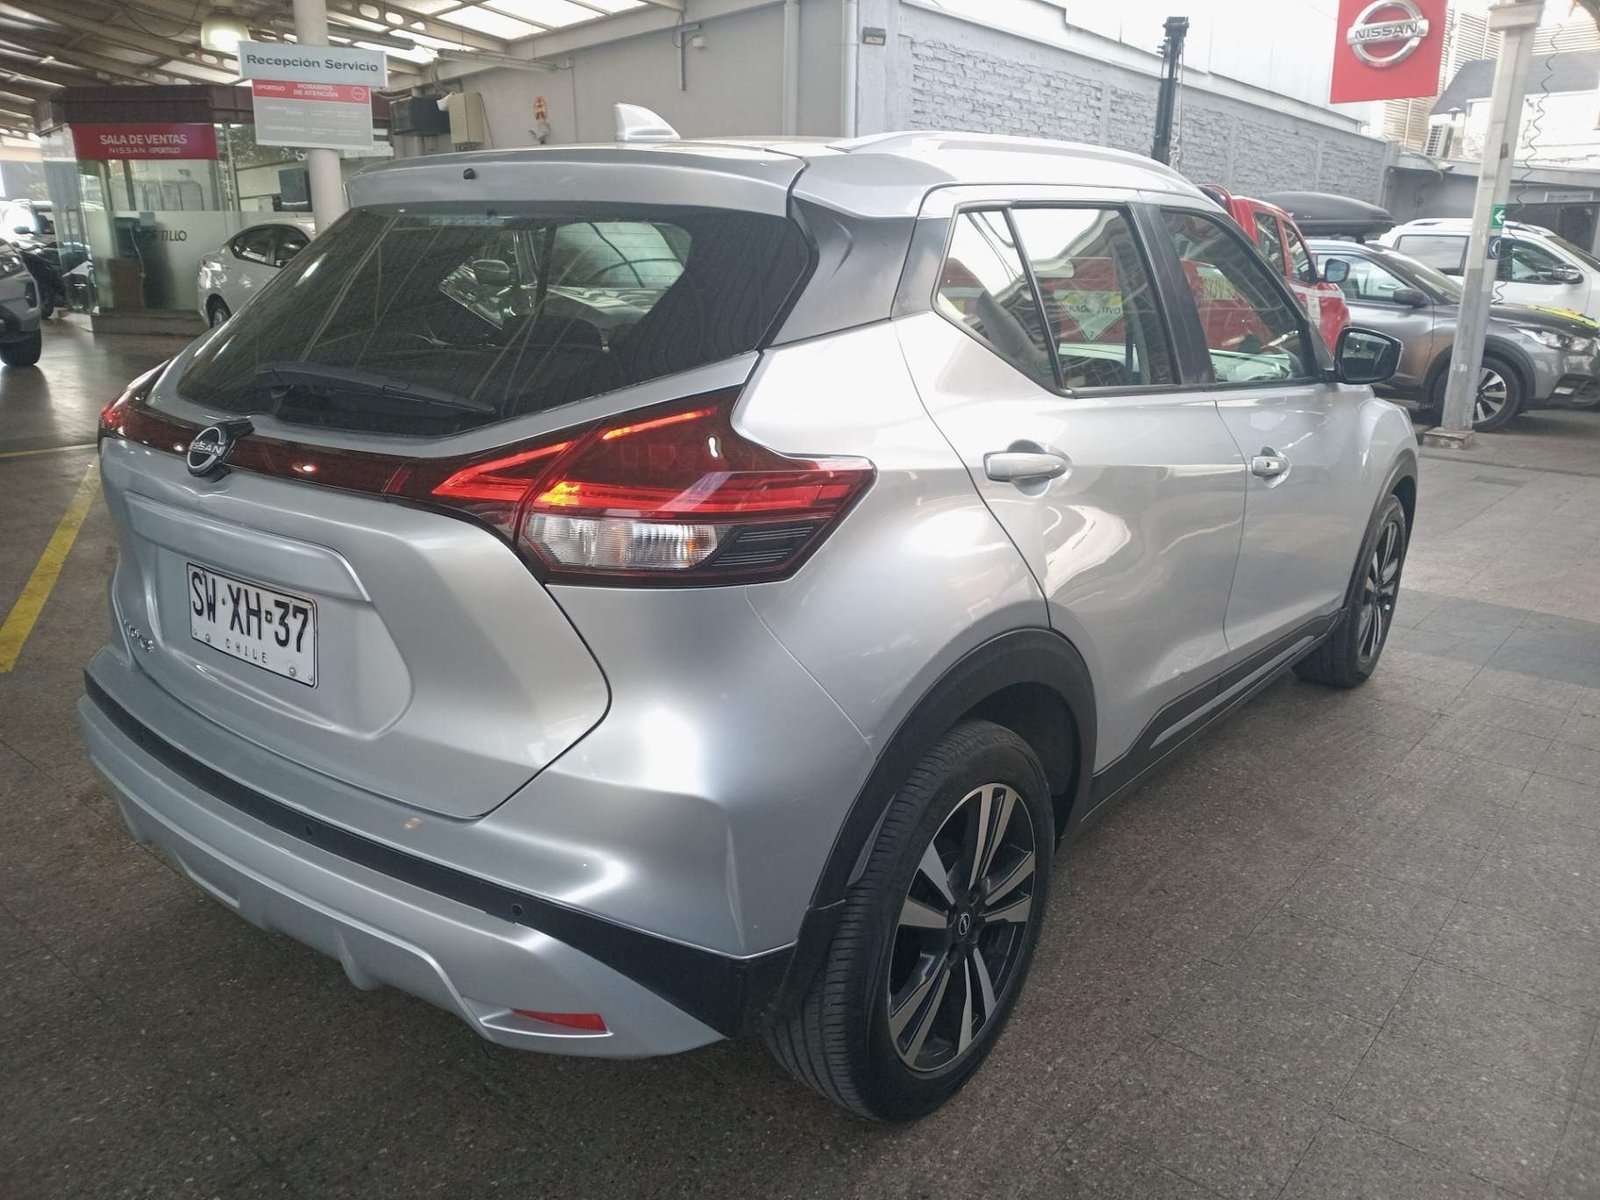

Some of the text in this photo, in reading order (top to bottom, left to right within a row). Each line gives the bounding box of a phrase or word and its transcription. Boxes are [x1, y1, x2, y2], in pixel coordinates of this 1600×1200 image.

[1354, 21, 1418, 40] NISSAN
[247, 54, 378, 72] Recepción Servicio
[101, 134, 188, 144] SALA DE VENTAS
[225, 637, 267, 664] CHILE
